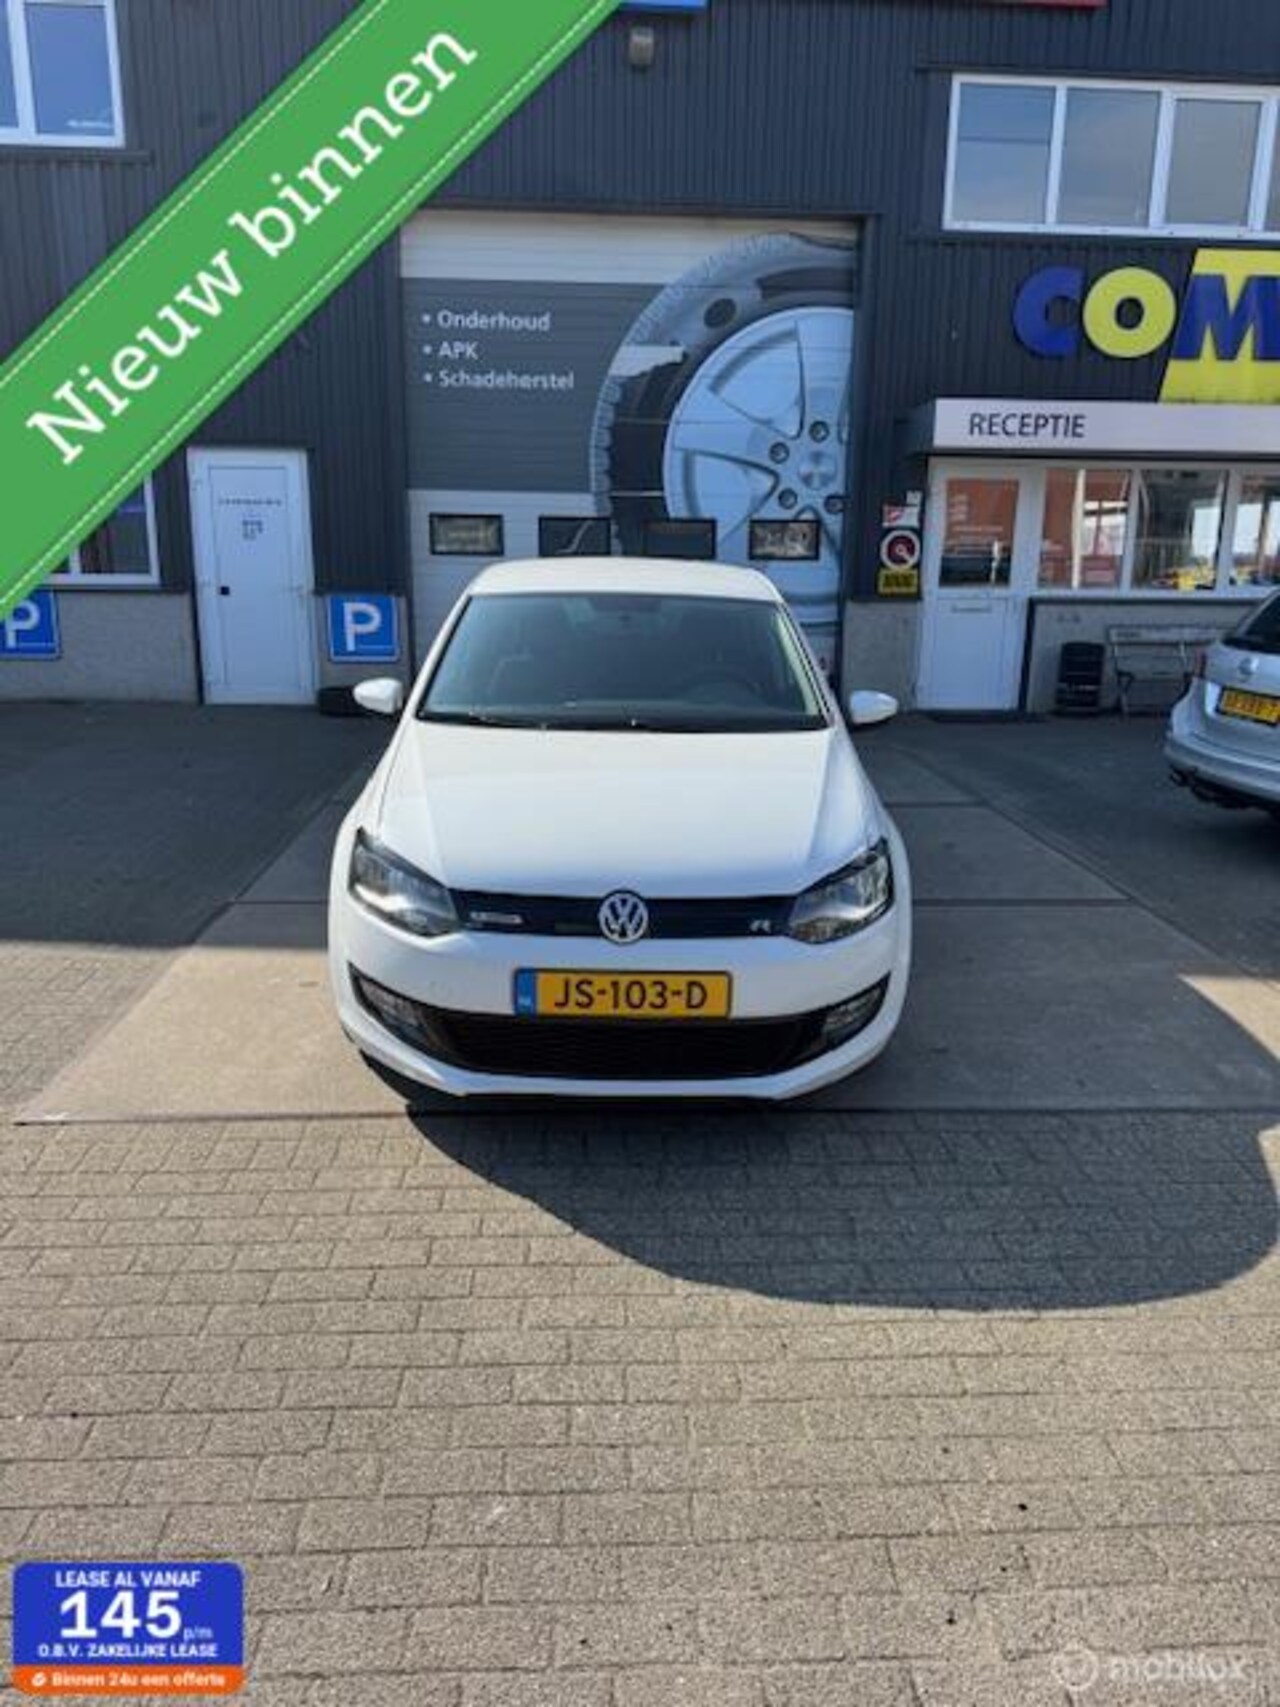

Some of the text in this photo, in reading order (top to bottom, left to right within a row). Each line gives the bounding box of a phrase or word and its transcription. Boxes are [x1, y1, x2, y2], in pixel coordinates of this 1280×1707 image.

[437, 309, 551, 331] Onderhoud
[438, 340, 479, 359] APK
[438, 369, 575, 390] Schadeherstel
[968, 412, 1086, 438] RECEPTIE
[343, 602, 382, 651] P
[554, 978, 707, 1009] JS-103-D
